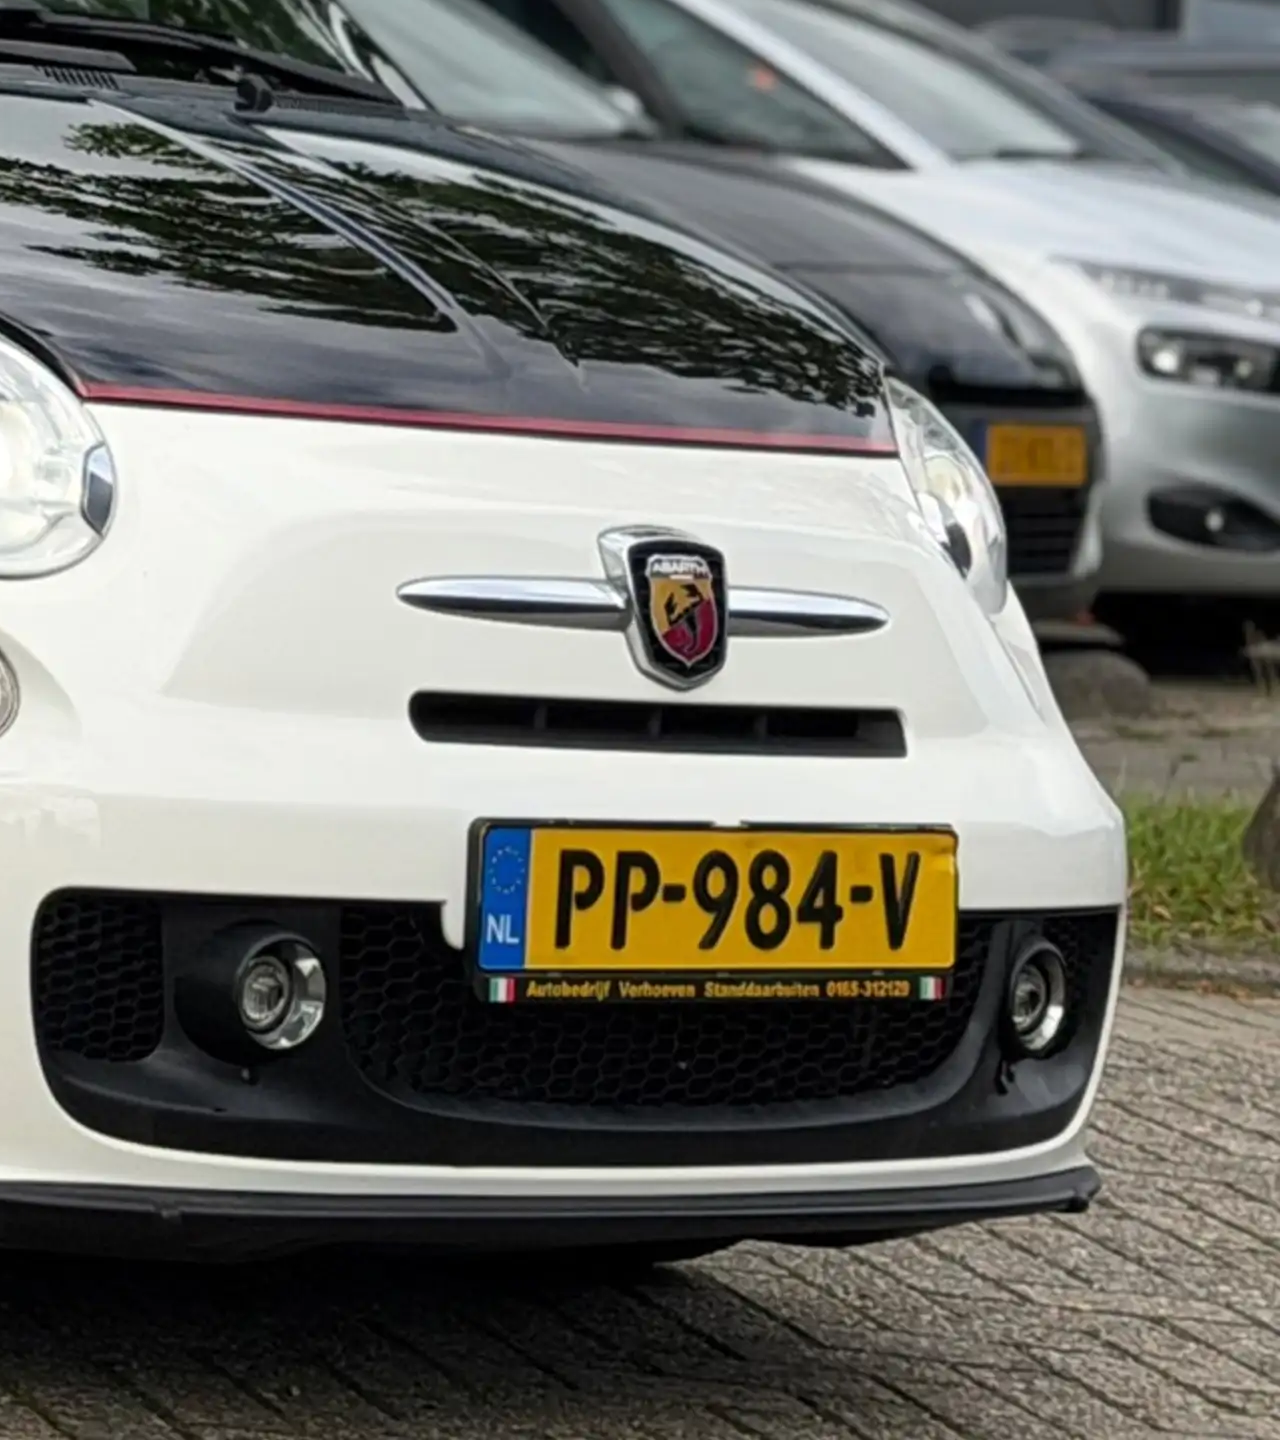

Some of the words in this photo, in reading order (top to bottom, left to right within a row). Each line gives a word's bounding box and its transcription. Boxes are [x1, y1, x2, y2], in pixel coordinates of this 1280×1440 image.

[554, 848, 922, 951] PP-984-V
[486, 913, 520, 945] NL
[526, 980, 611, 1002] Autobedrijf
[618, 980, 696, 998] Verhoeven
